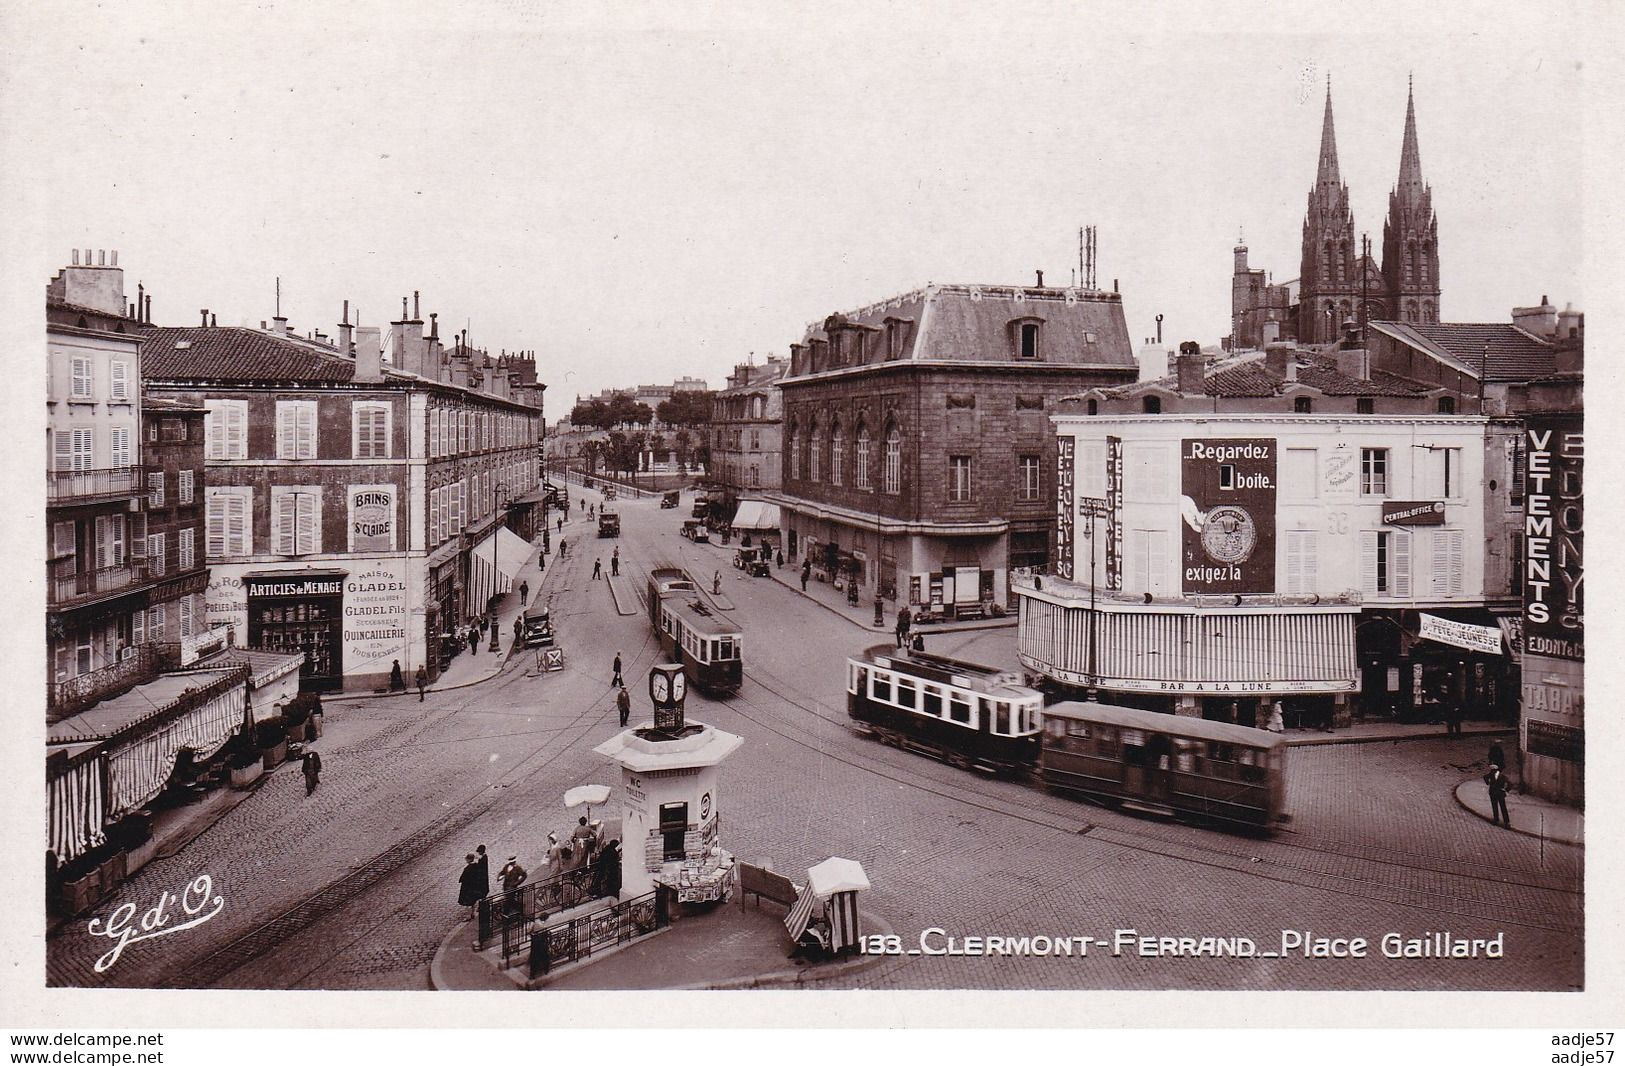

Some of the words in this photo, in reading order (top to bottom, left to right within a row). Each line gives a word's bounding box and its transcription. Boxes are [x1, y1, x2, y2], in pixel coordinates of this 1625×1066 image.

[356, 493, 389, 507] BAINS
[1114, 442, 1122, 588] VETEMENTS
[1526, 430, 1552, 623] VETEMENTS
[359, 571, 394, 580] MAISON
[1186, 564, 1226, 583] exigez
[1229, 565, 1241, 580] la
[249, 583, 296, 596] ARTICLES
[348, 582, 406, 592] GLADEL
[345, 606, 387, 616] GLADEL
[344, 629, 405, 641] QUINCAILLERIE
[1033, 661, 1044, 670] BAR
[1215, 683, 1230, 691] LA
[1242, 683, 1272, 691] LUNE
